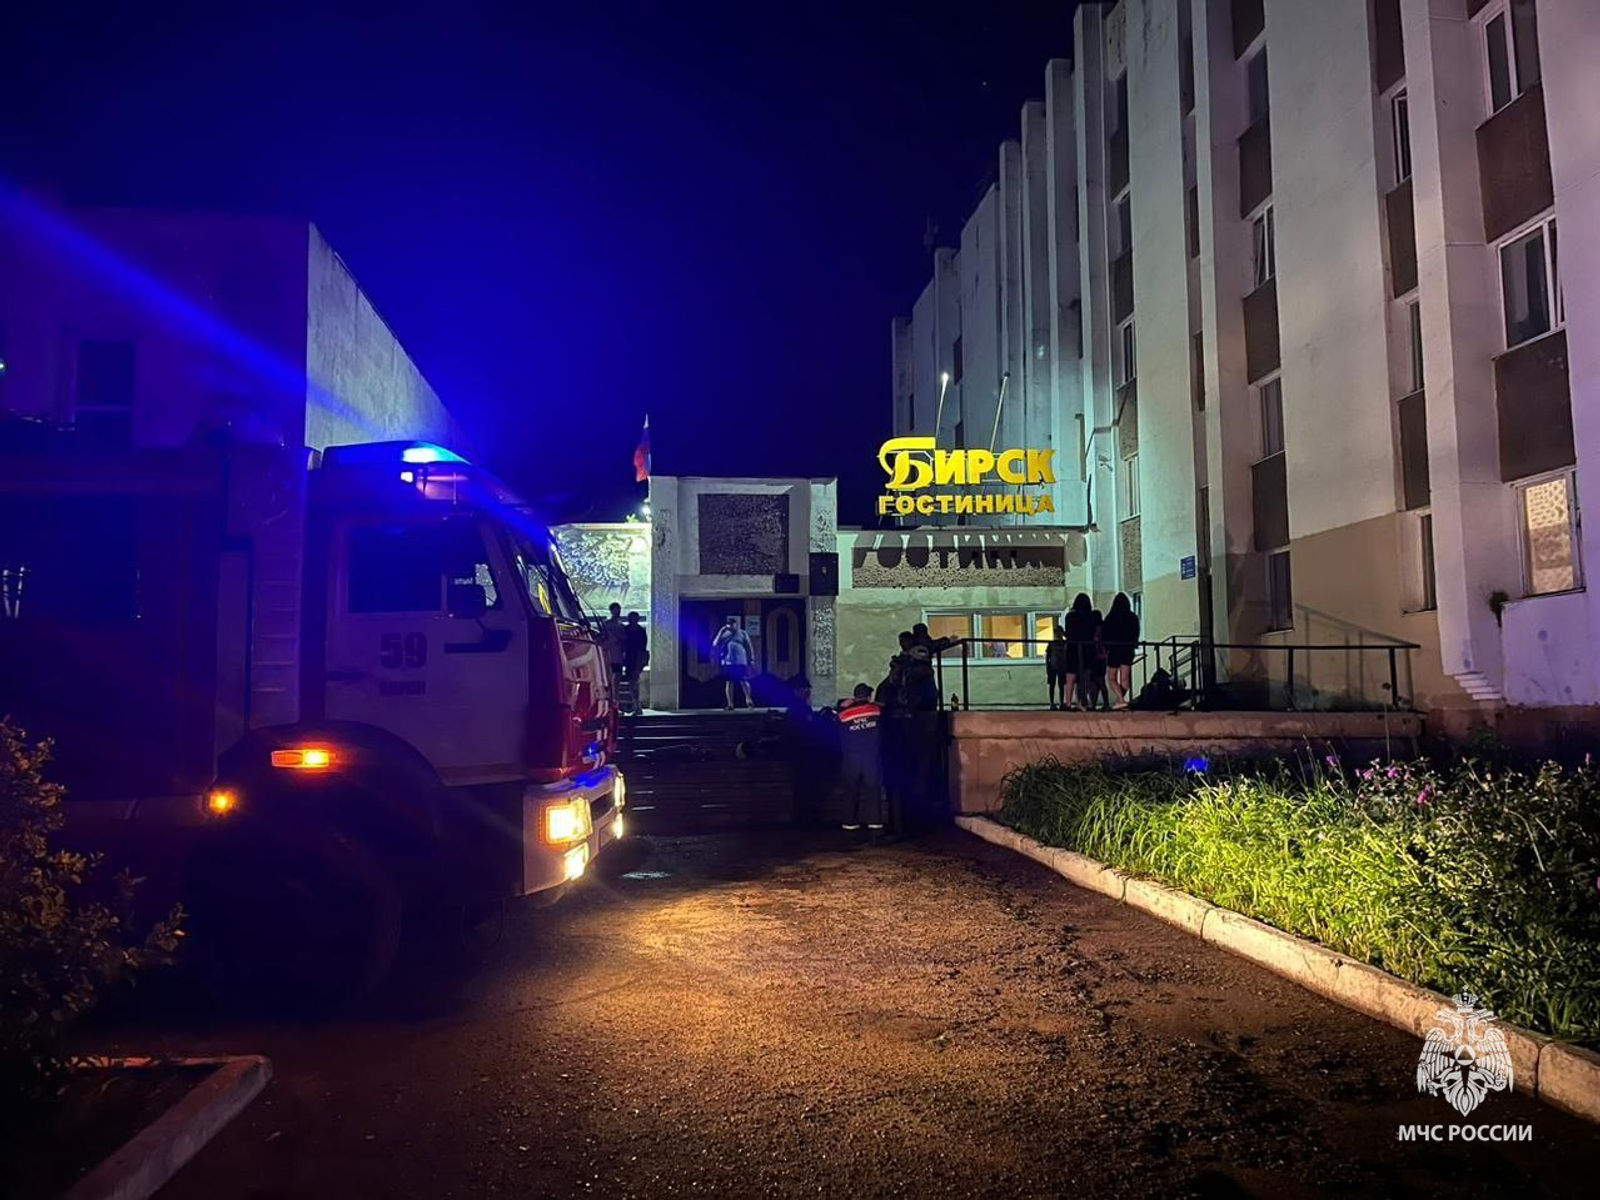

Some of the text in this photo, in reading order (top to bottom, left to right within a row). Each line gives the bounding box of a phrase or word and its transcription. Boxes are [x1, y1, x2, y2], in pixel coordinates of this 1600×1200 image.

[877, 436, 1057, 491] БИРСК
[878, 494, 1055, 516] ГОСТИНИЦА
[380, 631, 427, 669] 59
